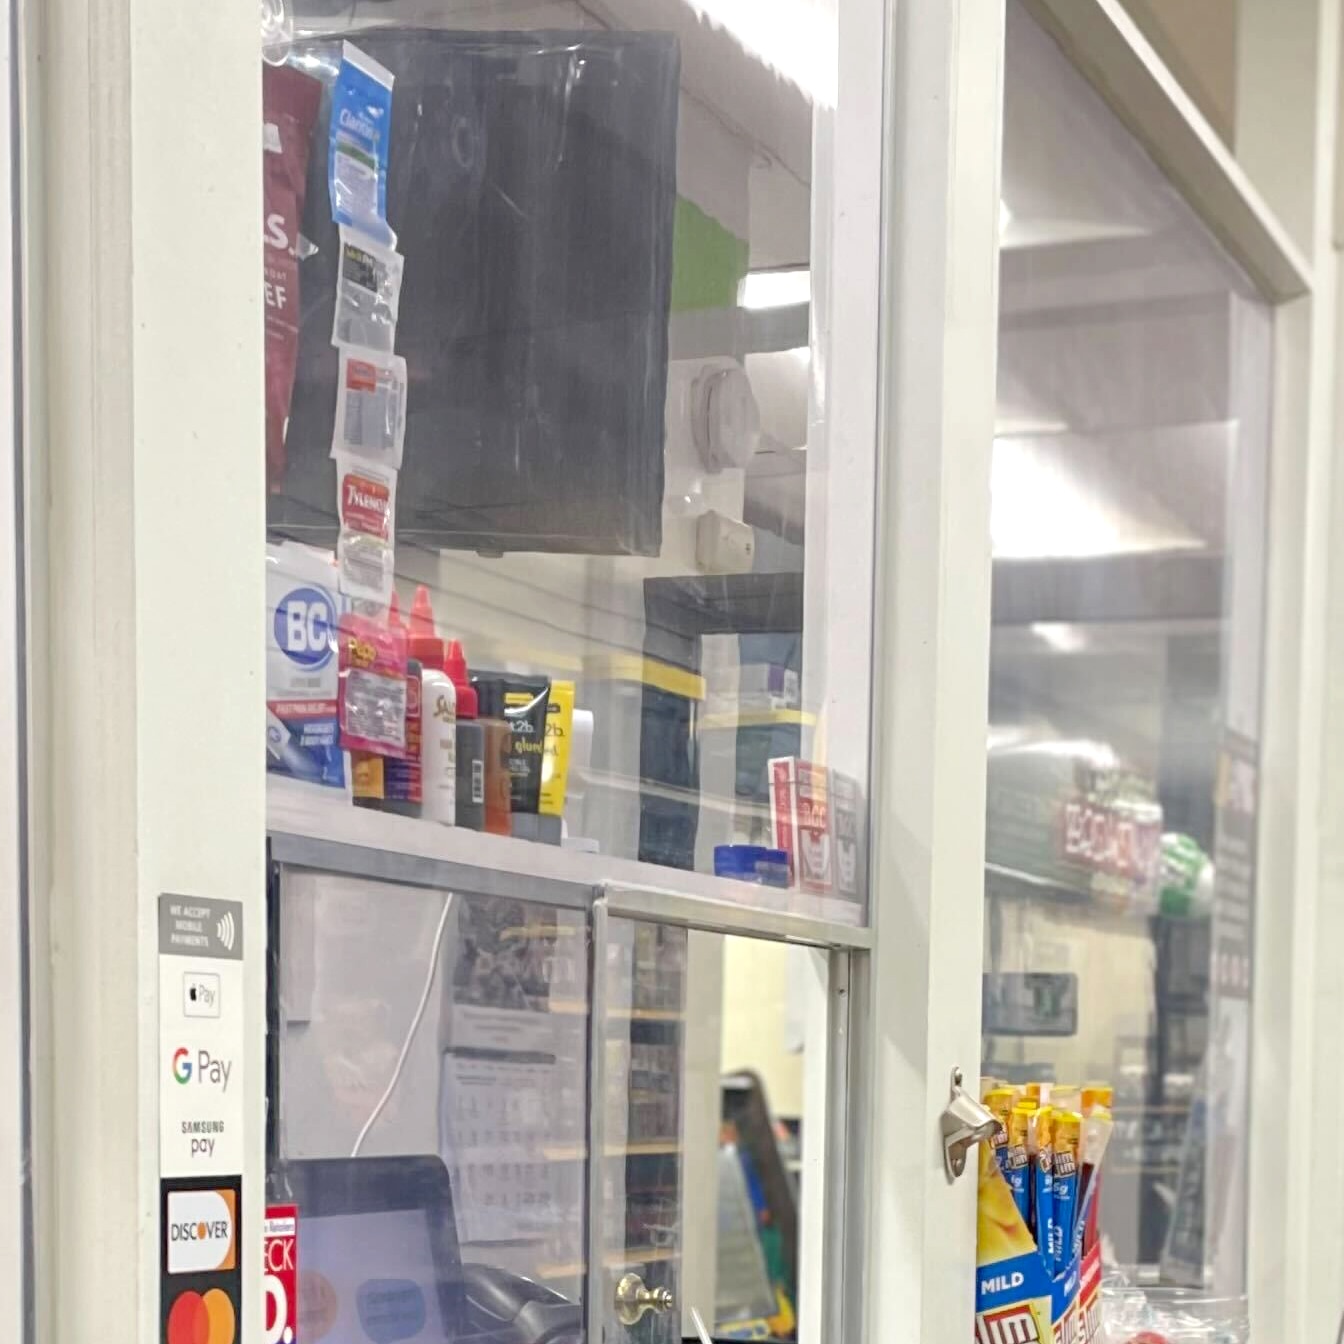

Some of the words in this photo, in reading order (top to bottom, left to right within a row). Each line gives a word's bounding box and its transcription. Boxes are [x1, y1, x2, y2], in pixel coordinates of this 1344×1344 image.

[287, 600, 328, 651] BC
[197, 1049, 233, 1093] Pay
[181, 1120, 225, 1134] SAMSUNG
[190, 1137, 216, 1158] pay
[171, 1221, 228, 1242] DISCOVER
[981, 1271, 1025, 1295] MILD
